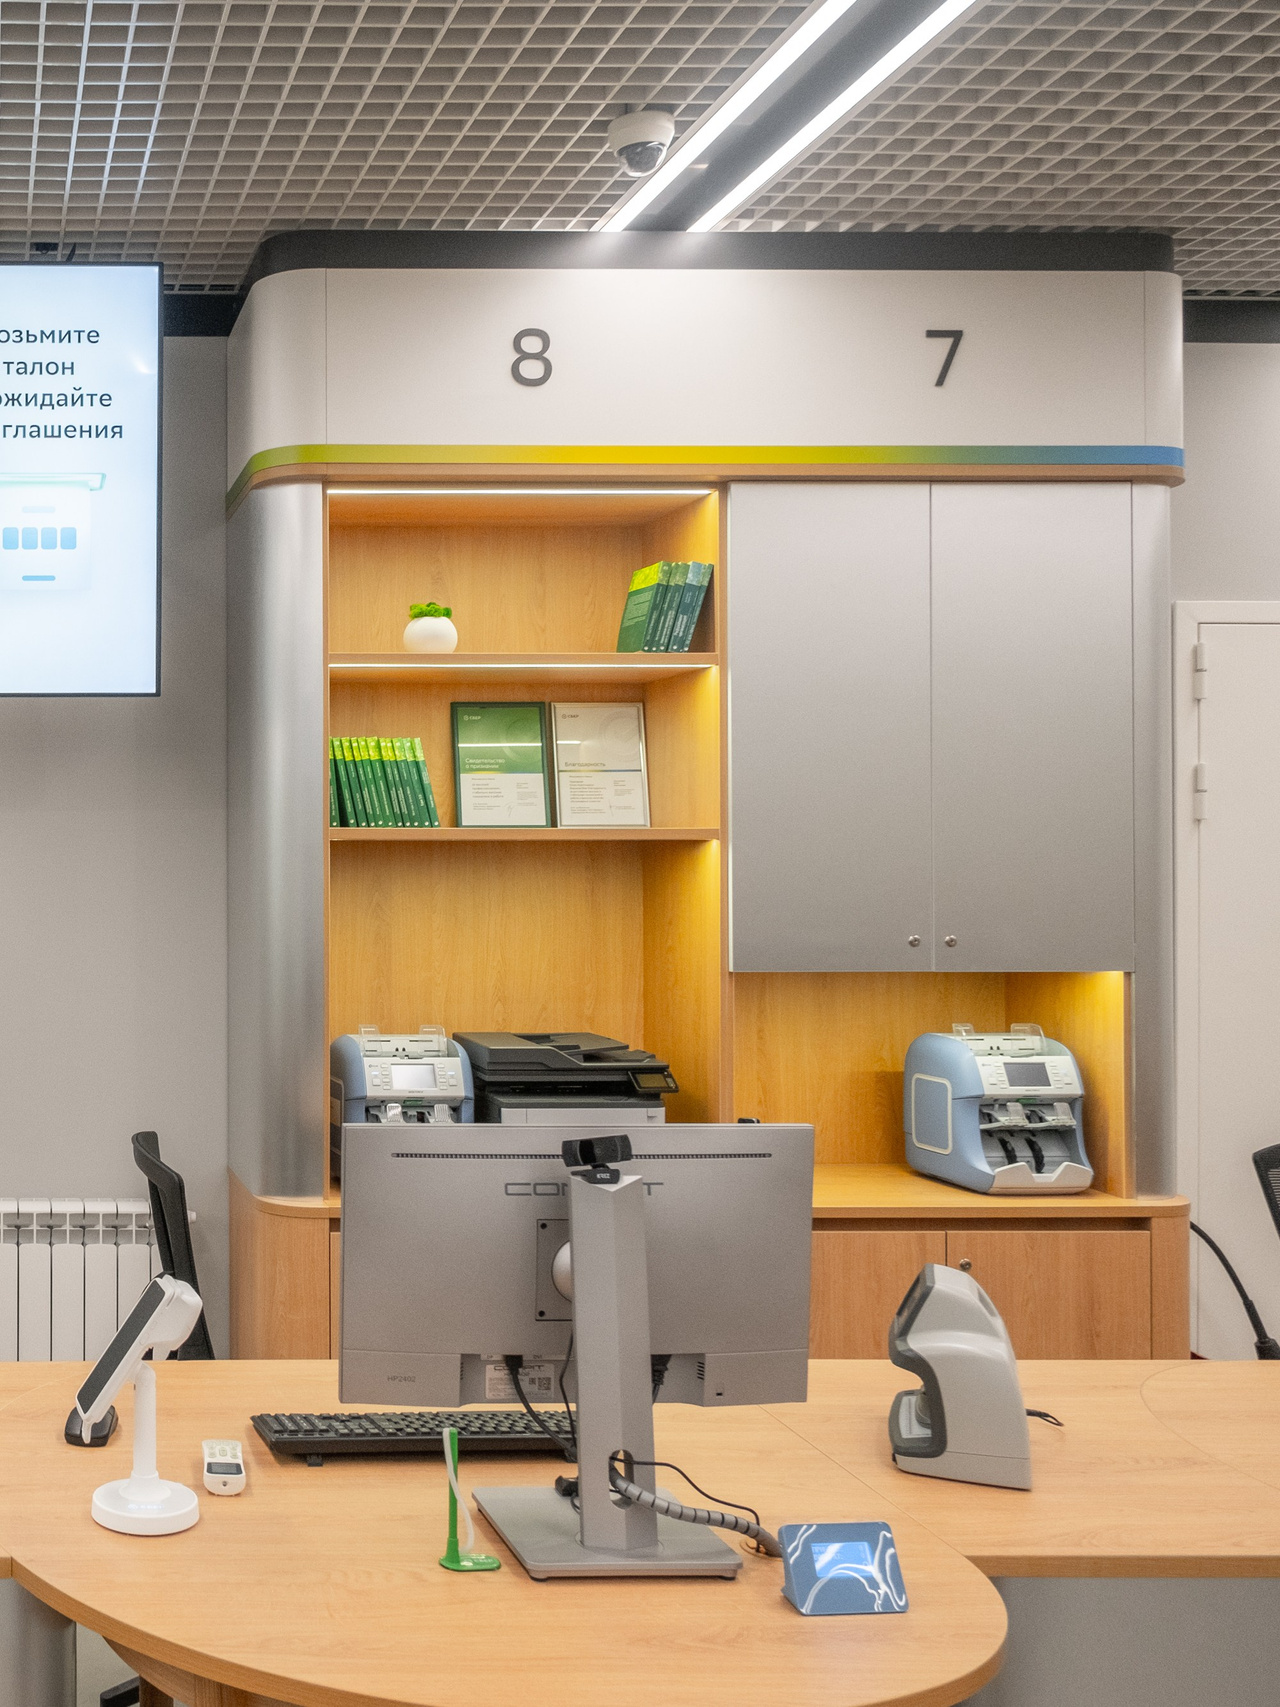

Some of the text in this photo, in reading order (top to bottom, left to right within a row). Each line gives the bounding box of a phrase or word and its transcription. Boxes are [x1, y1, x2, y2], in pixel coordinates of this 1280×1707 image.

[3, 361, 75, 376] талон
[511, 328, 553, 387] 8
[925, 329, 964, 387] 7
